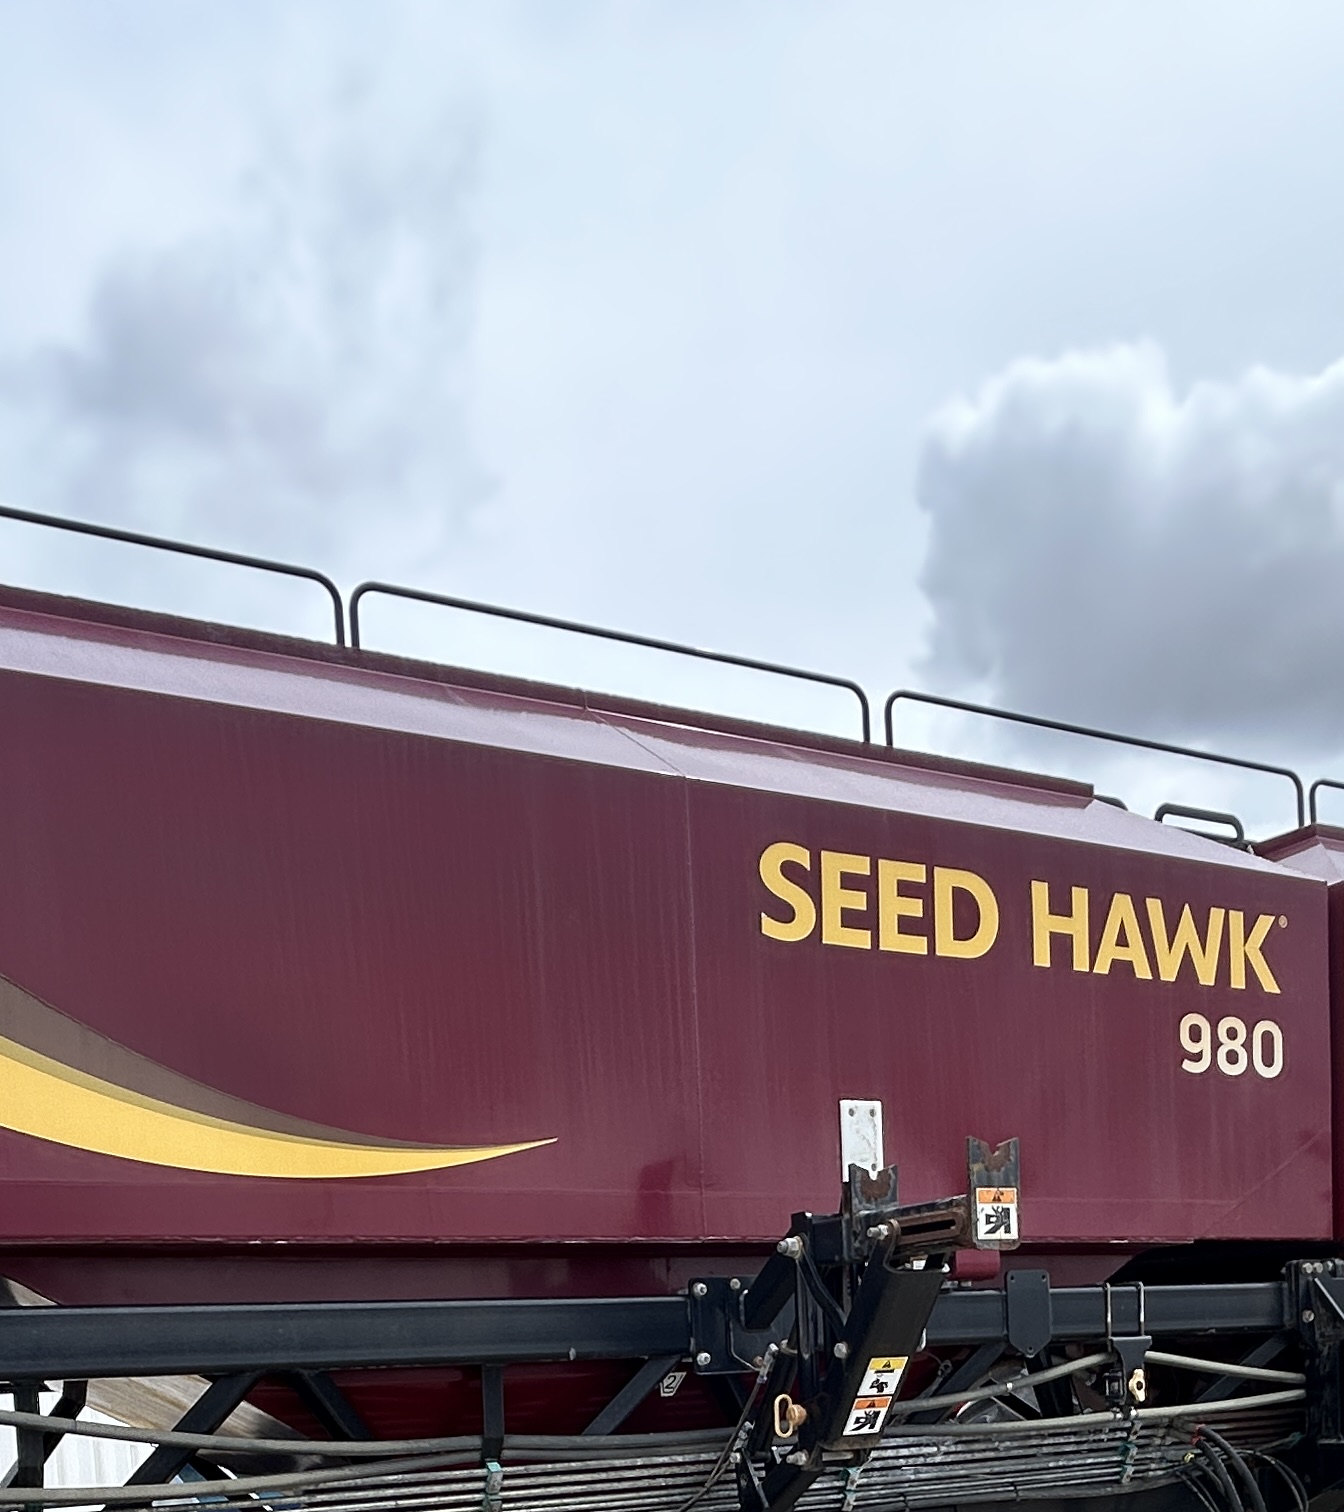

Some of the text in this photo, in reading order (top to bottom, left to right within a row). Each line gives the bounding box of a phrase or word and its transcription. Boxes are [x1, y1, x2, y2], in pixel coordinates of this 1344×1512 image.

[759, 842, 1281, 994] SEED HAWK
[1179, 1013, 1284, 1079] 980
[664, 1375, 677, 1389] 2
